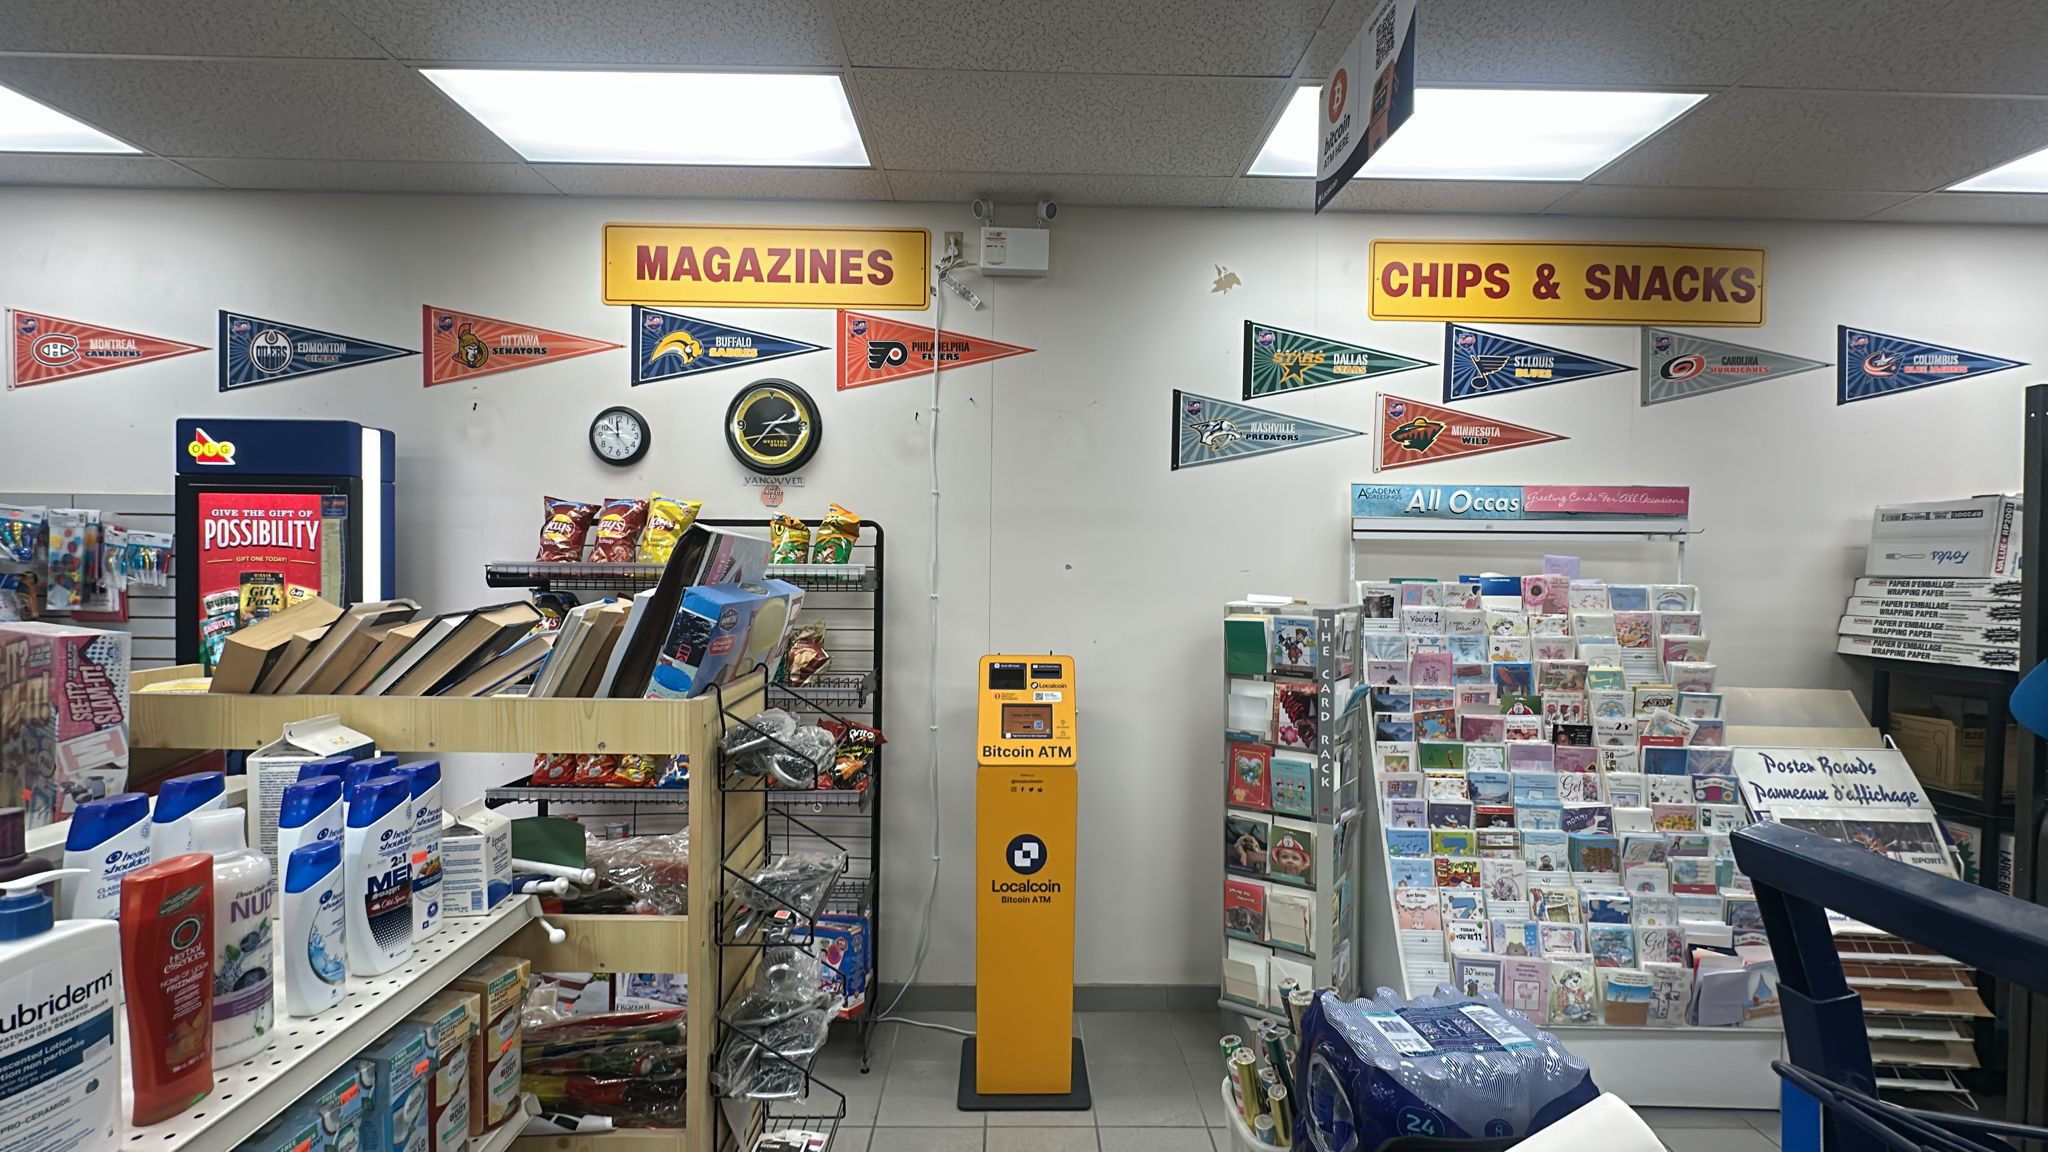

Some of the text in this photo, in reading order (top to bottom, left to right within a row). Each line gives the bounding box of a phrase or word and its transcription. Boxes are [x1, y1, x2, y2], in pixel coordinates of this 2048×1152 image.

[1324, 113, 1351, 156] bitcoin
[636, 244, 895, 287] MAGAZINES
[1381, 261, 1757, 304] CHIPS & SNACKS
[89, 338, 137, 350] MONTREAL
[298, 342, 347, 354] EDMONTON
[500, 335, 540, 348] OTTAWA
[715, 335, 752, 348] BUFFALO
[84, 350, 142, 358] CANADIENS
[256, 345, 289, 359] OILERS
[492, 347, 548, 355] SENATORS
[1272, 351, 1326, 364] STARS
[1333, 353, 1368, 366] DALLAS
[1722, 355, 1759, 366] CAROLINA
[1913, 354, 1959, 366] COLUMBUS
[1332, 365, 1367, 374] STARS
[1514, 367, 1553, 378] BLUES
[1250, 421, 1296, 434] NASHVILLE
[1451, 425, 1501, 437] MINNESOTA
[1245, 433, 1300, 442] PREDATORS
[1461, 437, 1489, 445] WILD
[743, 476, 804, 487] VANCOUVER
[1357, 488, 1401, 499] ACADEMY
[1525, 491, 1684, 508] Greeting Cards For All Occasions
[1404, 488, 1441, 514] All
[211, 509, 238, 517] GIVE
[242, 509, 265, 517] THE
[204, 518, 320, 550] POSSIBILITY
[1931, 551, 1970, 564] Forks
[250, 586, 275, 596] Gift
[247, 596, 280, 607] Pack
[1881, 600, 1903, 608] PAPIER
[1874, 619, 1896, 627] PAPIER
[1321, 618, 1332, 657] THE
[1872, 627, 1933, 638] WRAPPING PAPER
[1873, 639, 1895, 647] PAPIER
[1871, 648, 1931, 659] WRAPPING PAPER
[80, 664, 123, 724] SLAM-IT!
[1320, 669, 1331, 722] CARD
[982, 745, 1072, 758] Bitcoin ATM
[1320, 735, 1331, 787] RACK
[1758, 752, 1876, 777] Poster Boards
[1749, 781, 1919, 808] Panneaux d'affichage
[992, 879, 1061, 892] Localcoin
[170, 943, 201, 965] Herbal
[0, 971, 113, 1034] ubriderm
[44, 1036, 73, 1054] Lotion
[23, 1060, 42, 1074] non
[1406, 1113, 1435, 1135] 24
